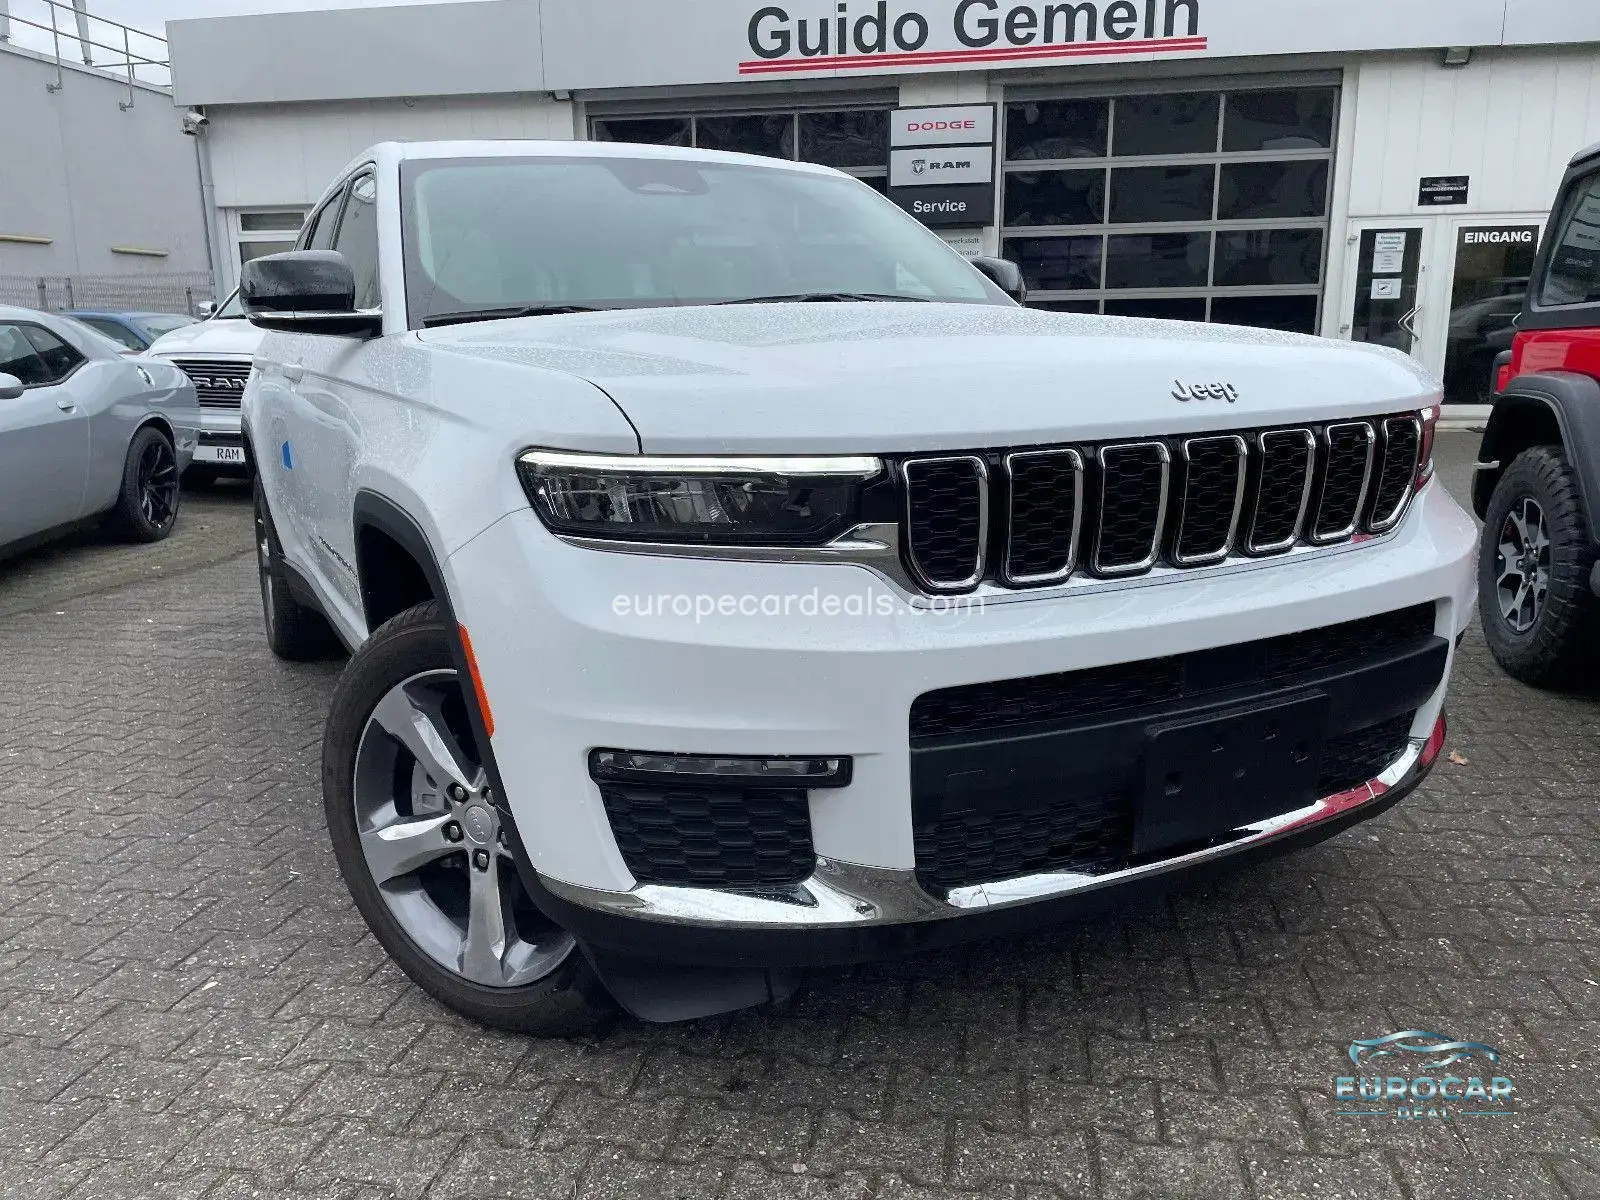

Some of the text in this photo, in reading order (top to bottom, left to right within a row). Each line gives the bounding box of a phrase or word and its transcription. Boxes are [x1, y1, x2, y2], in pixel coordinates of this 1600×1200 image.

[748, 1, 929, 59] Guido
[907, 120, 976, 132] DODGE
[929, 161, 971, 170] RAM
[913, 200, 967, 213] Service
[1464, 231, 1532, 243] EINGANG
[1171, 379, 1239, 403] Jeep
[216, 448, 240, 460] RAM
